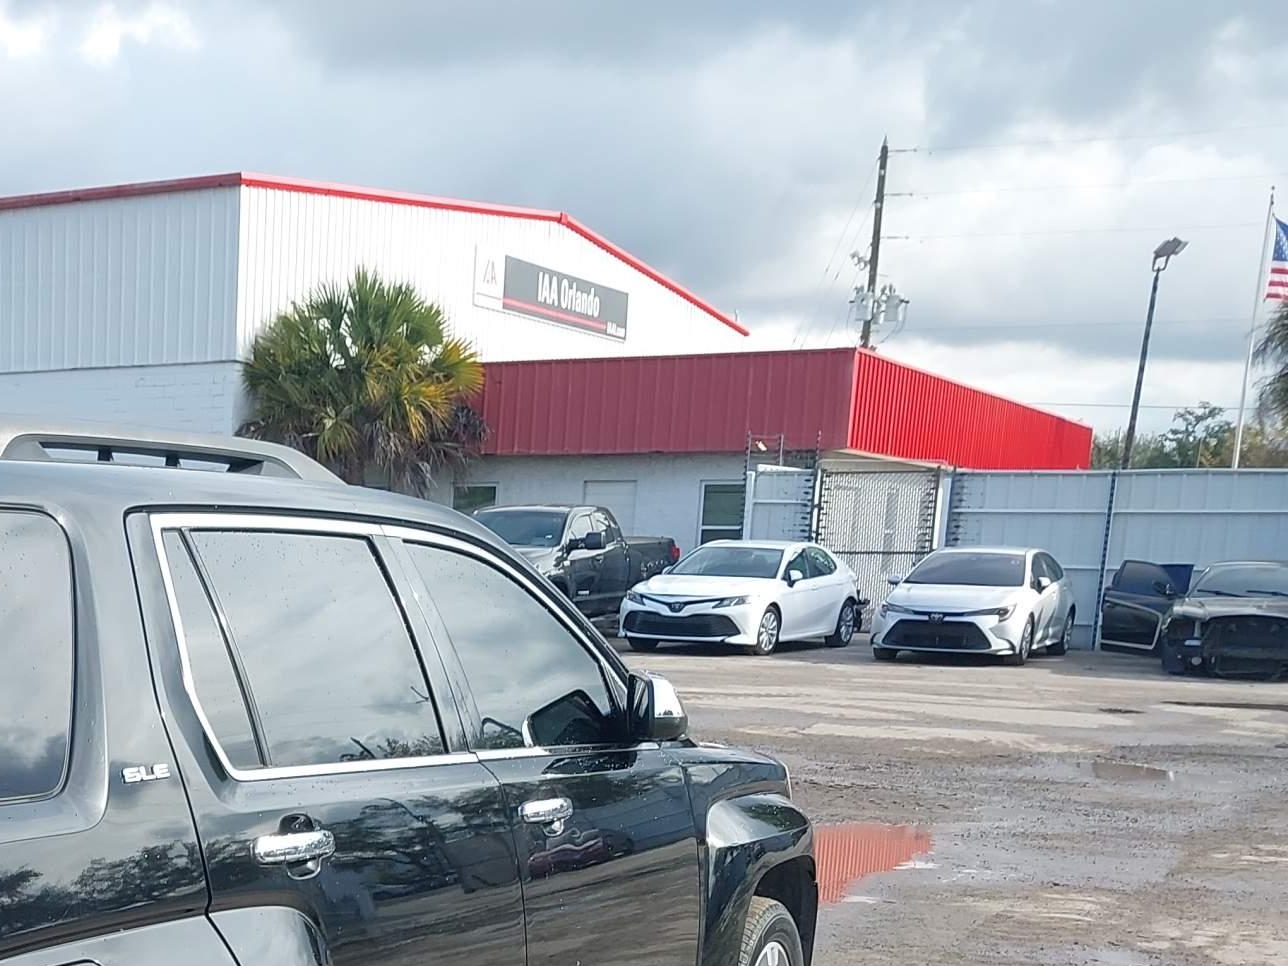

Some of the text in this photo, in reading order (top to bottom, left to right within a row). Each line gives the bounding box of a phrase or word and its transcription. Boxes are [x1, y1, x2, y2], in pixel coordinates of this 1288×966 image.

[537, 271, 559, 307] IAA
[560, 277, 600, 318] Orlando
[122, 763, 171, 783] SLE
